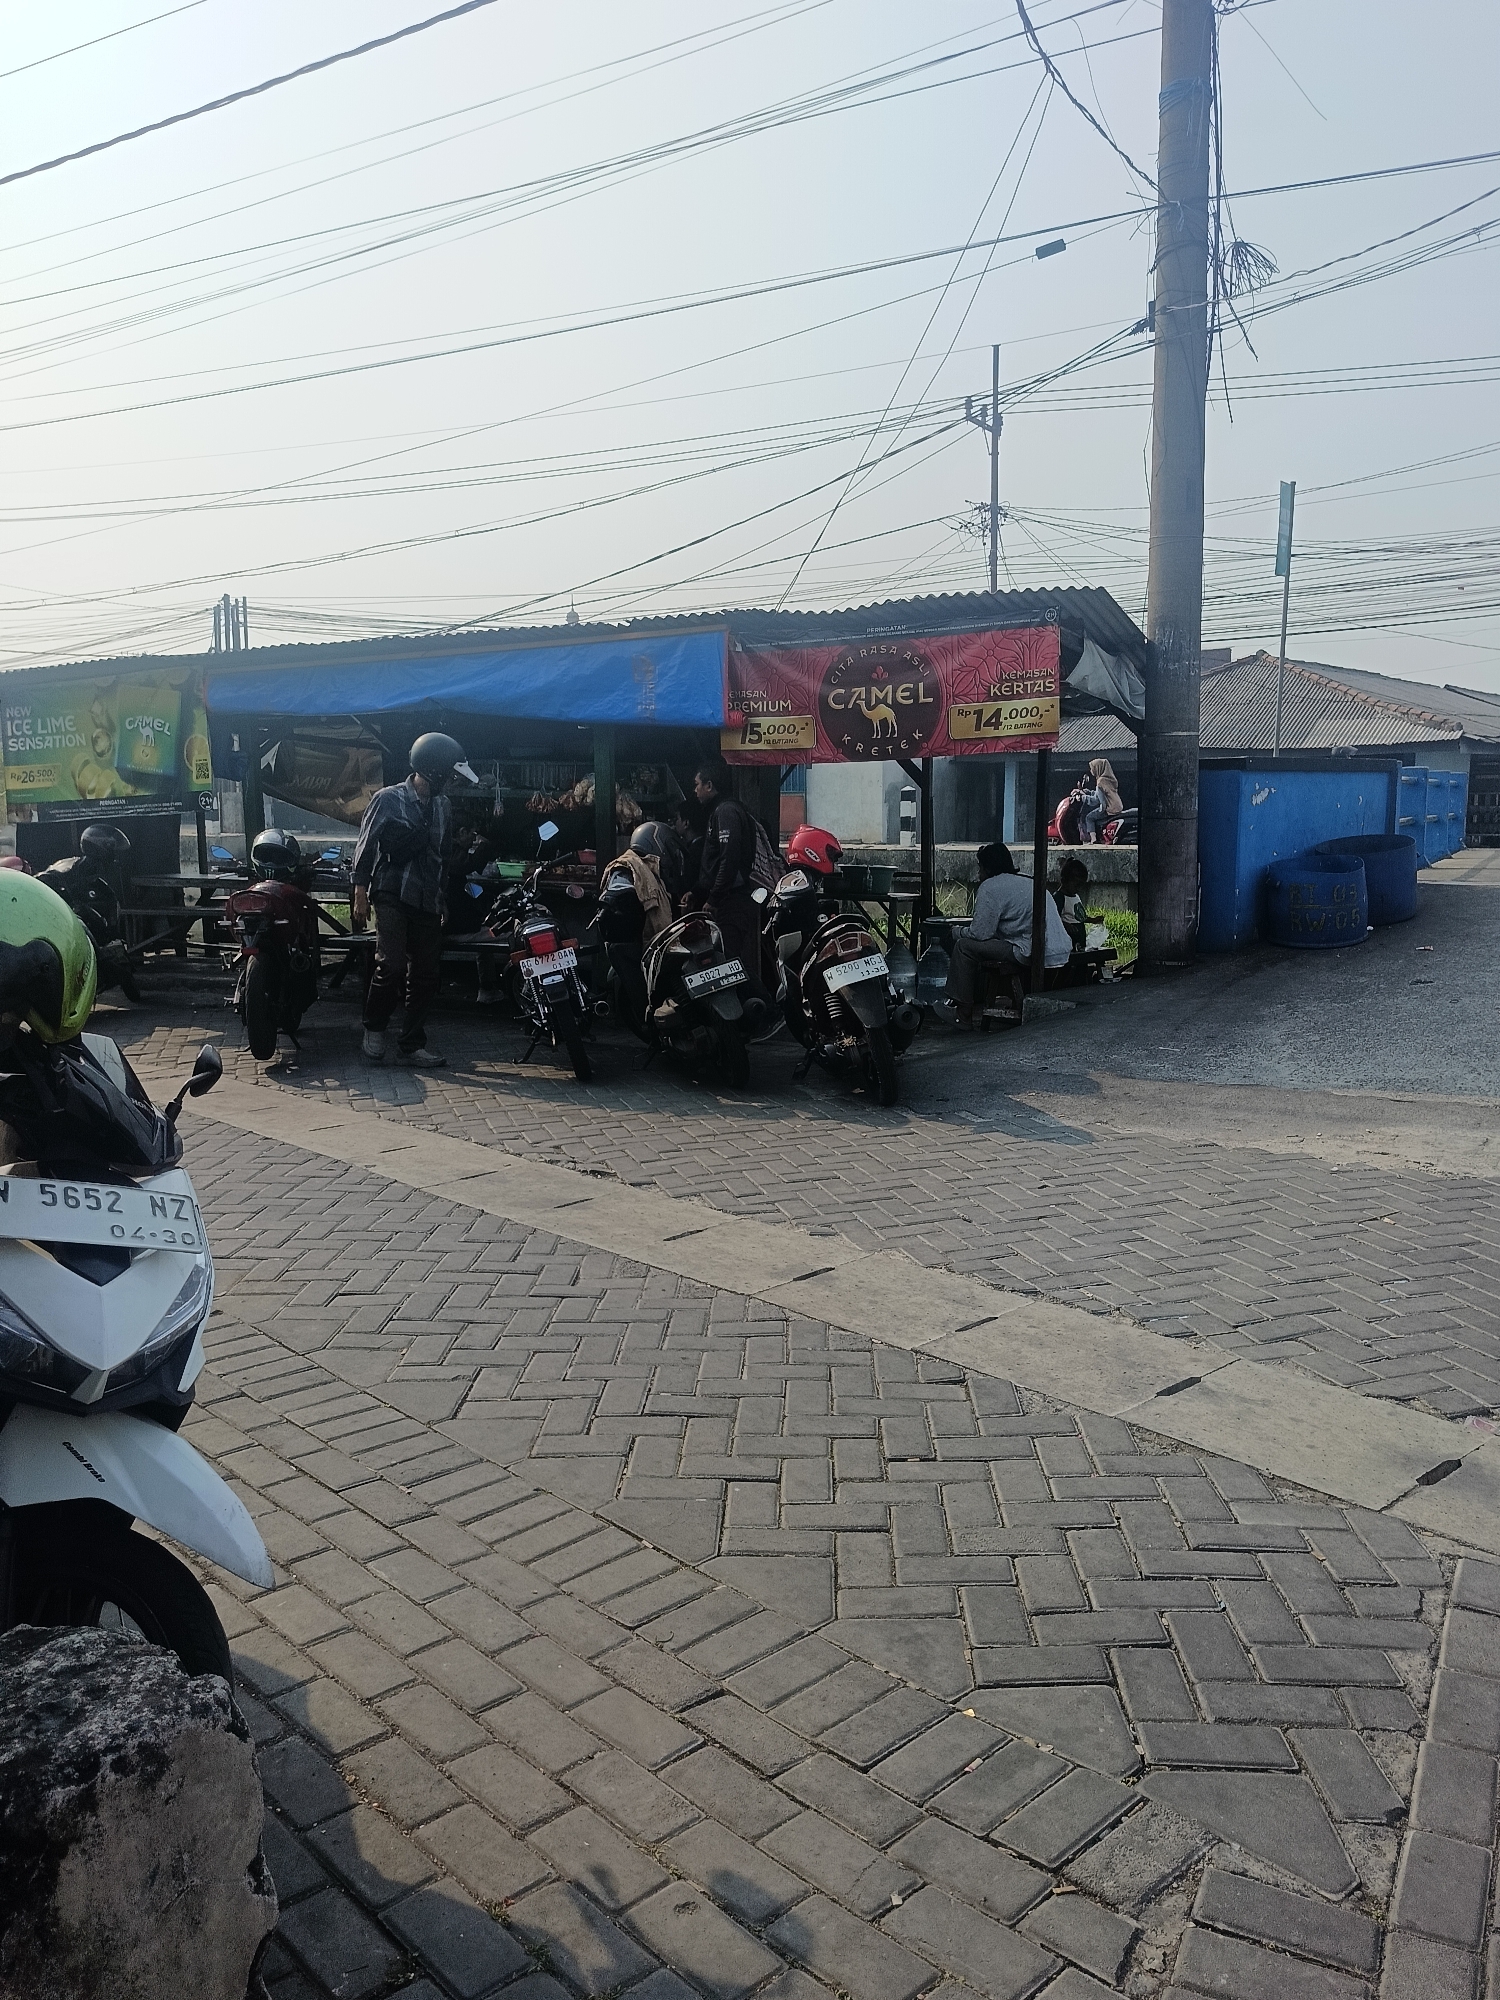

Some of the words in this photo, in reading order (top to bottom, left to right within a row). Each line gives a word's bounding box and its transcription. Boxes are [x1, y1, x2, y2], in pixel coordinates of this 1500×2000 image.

[831, 656, 854, 684] CITA
[860, 645, 897, 658] RASA
[903, 651, 930, 677] ASLI
[1002, 667, 1055, 680] KEMASAN
[728, 690, 767, 699] EMASAN
[827, 682, 934, 710] CAMEL
[990, 678, 1056, 697] KERTAS
[6, 706, 32, 718] NEW
[7, 719, 33, 737] ICE
[38, 715, 77, 734] LIME
[125, 715, 171, 736] CAMEL
[1013, 722, 1043, 730] BATANG
[8, 733, 87, 751] SENSATION
[842, 729, 923, 756] KRETEK
[521, 960, 532, 969] AG
[534, 953, 556, 966] 6772
[836, 961, 860, 976] 5290
[687, 977, 694, 986] P
[699, 968, 721, 983] 5027
[39, 1183, 124, 1214] 5652
[149, 1195, 189, 1221] NZ
